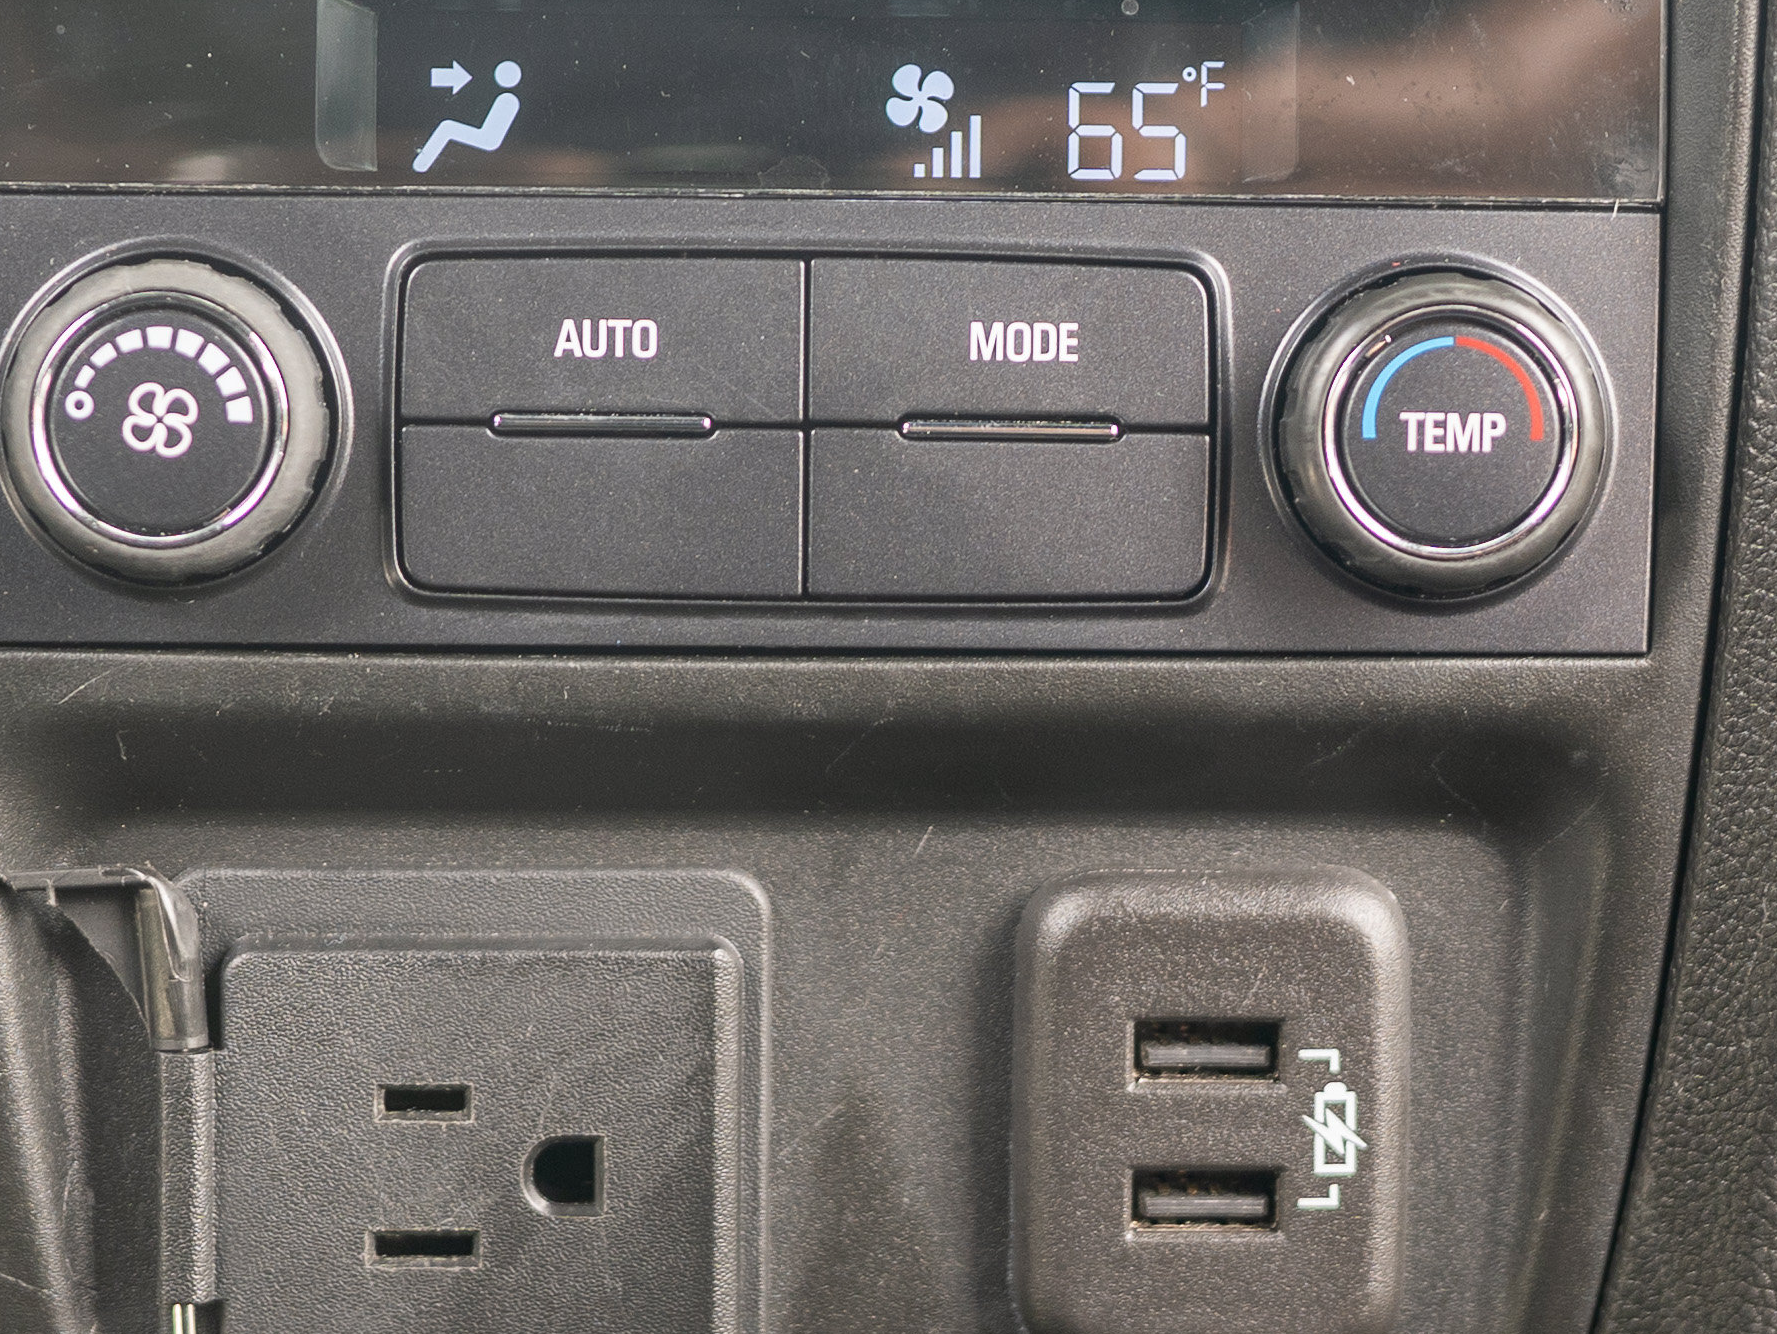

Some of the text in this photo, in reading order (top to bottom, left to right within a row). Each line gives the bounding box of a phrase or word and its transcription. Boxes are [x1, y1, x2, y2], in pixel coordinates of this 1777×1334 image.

[553, 318, 658, 358] AUTO
[969, 321, 1079, 362] MODE
[1399, 412, 1506, 453] TEMP
